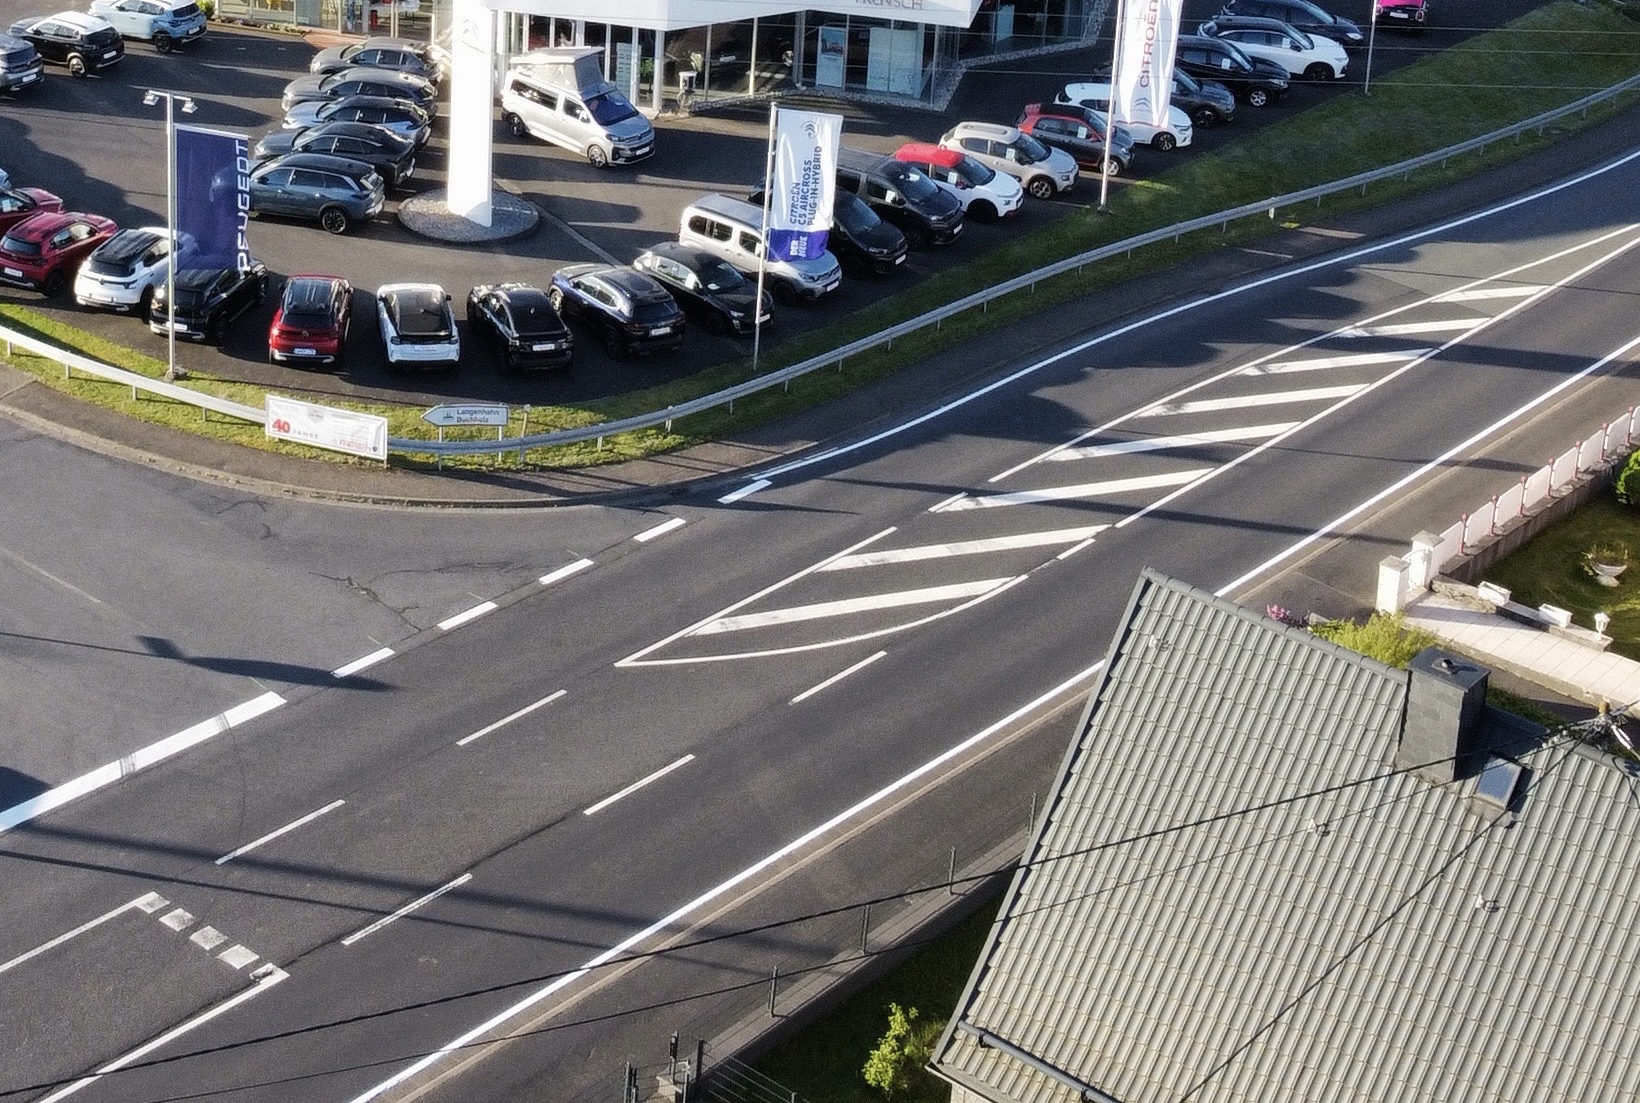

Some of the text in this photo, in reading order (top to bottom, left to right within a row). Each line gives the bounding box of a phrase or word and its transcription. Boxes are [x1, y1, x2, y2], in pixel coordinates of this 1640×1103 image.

[235, 139, 251, 273] PEUGEOT
[797, 160, 813, 226] C5 AIRCROSS
[807, 146, 823, 226] PLUG-IN-HYBRID
[790, 239, 799, 256] DER
[272, 418, 291, 434] 40
